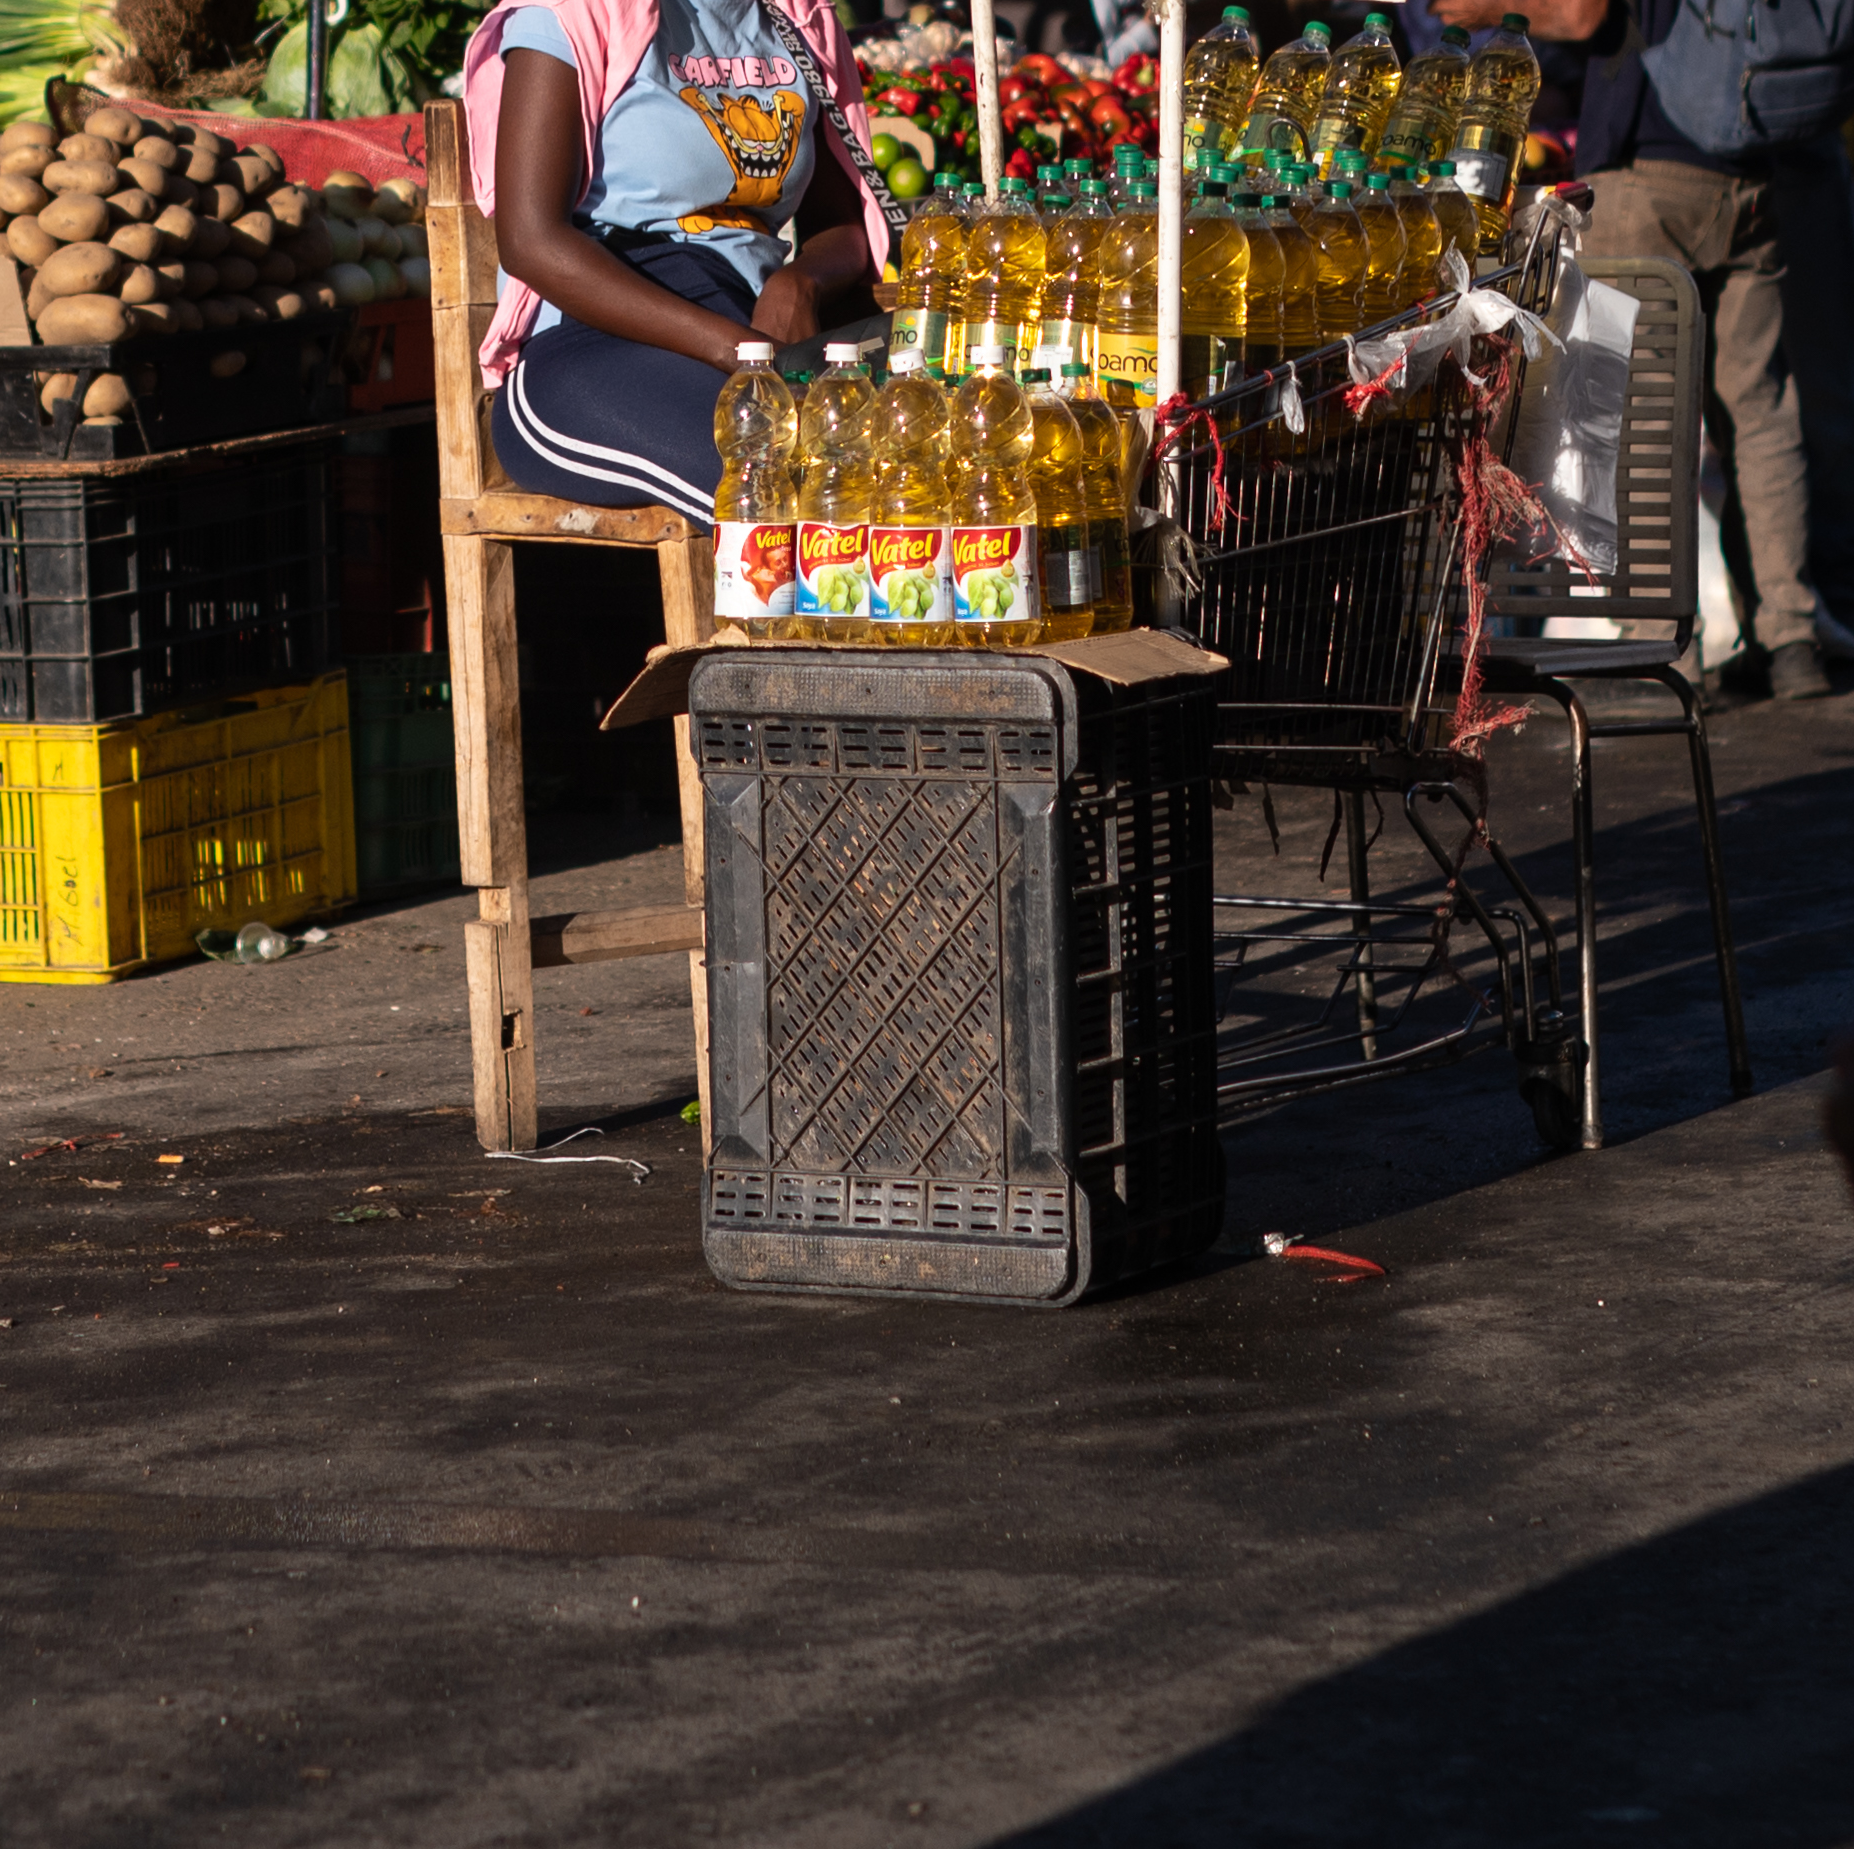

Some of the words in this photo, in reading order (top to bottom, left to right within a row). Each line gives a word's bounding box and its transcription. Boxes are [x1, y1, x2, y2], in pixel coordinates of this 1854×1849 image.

[668, 53, 798, 88] GARFIELD
[755, 529, 792, 549] Vatel
[802, 528, 864, 560] Vatel
[872, 533, 934, 565] Vatel
[953, 531, 1012, 566] Vatel
